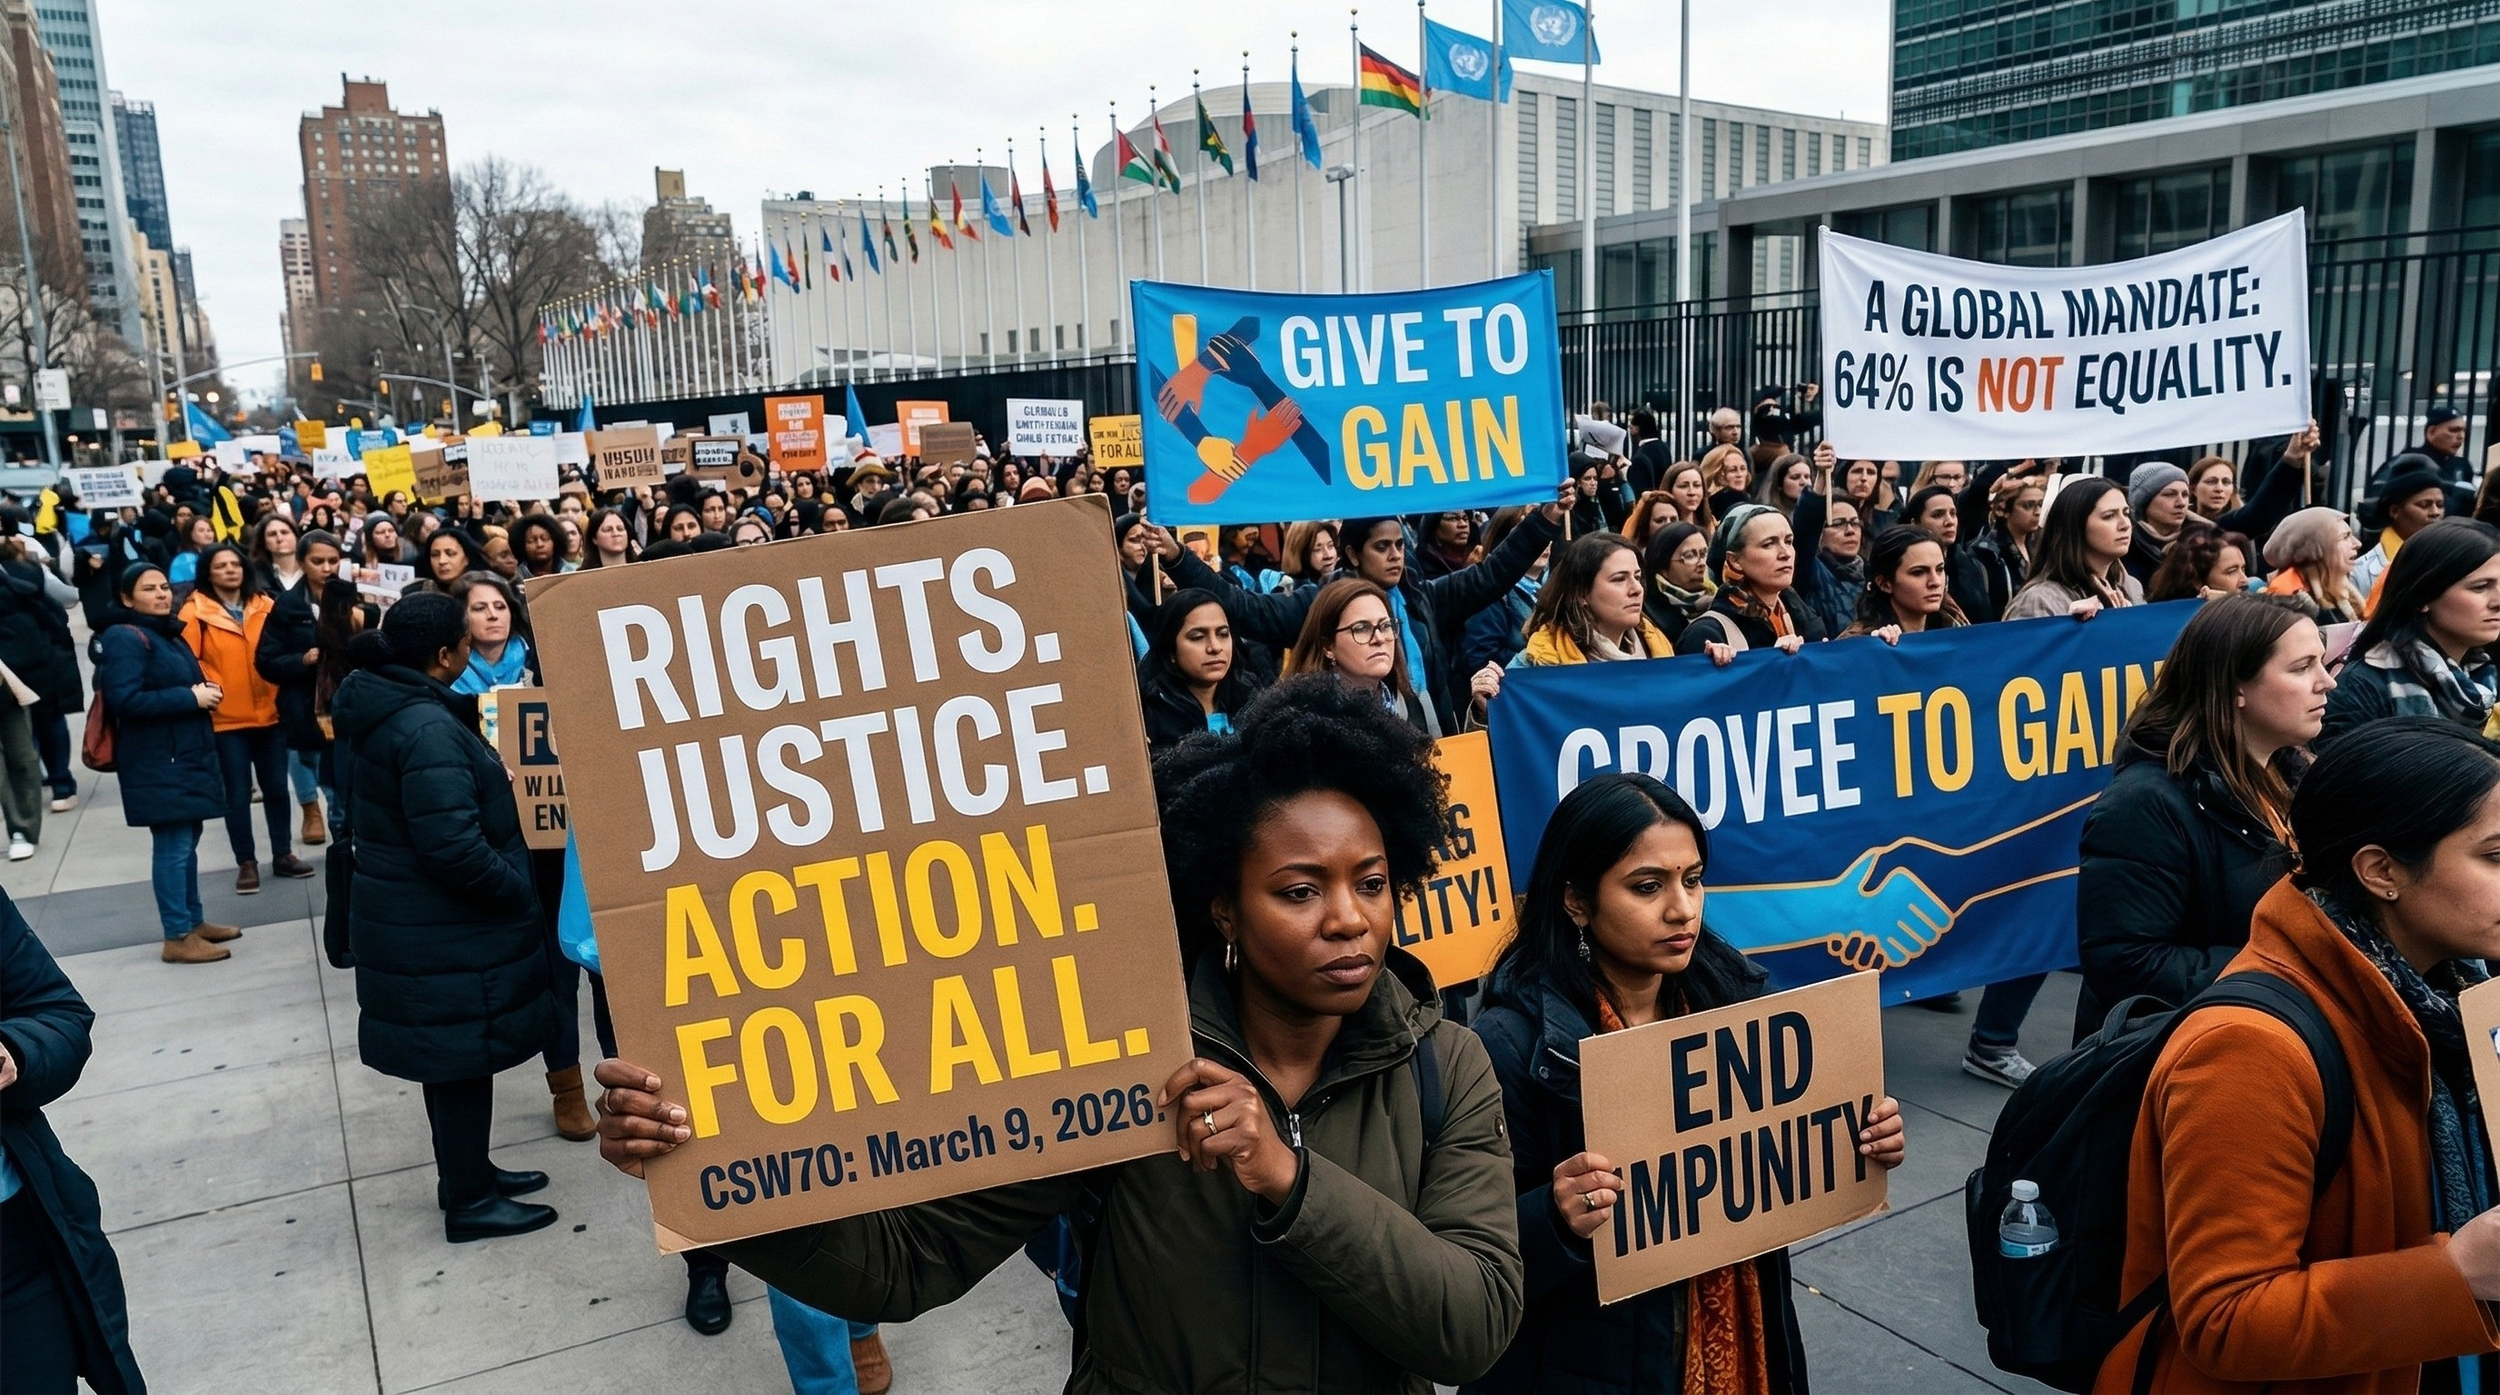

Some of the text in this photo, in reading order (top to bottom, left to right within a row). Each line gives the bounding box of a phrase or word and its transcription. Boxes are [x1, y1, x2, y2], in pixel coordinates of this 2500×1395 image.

[1280, 302, 1529, 389] GIVE TO
[1864, 265, 2260, 340] A GLOBAL MANDATE:
[1834, 330, 2292, 415] 64% IS NOT EQUALITY.
[1100, 443, 1122, 458] FOR
[1341, 395, 1525, 491] GAIN
[597, 547, 1061, 730] RIGHTS.
[637, 683, 1110, 872] JUSTICE.
[1877, 686, 1974, 798] TO
[664, 824, 1099, 1007] ACTION.
[675, 955, 1150, 1139] FOR ALL.
[1670, 1011, 1813, 1133] END
[699, 1083, 1167, 1211] CSW70: March 9, 2026.
[1611, 1094, 1874, 1258] IMPUNITY
